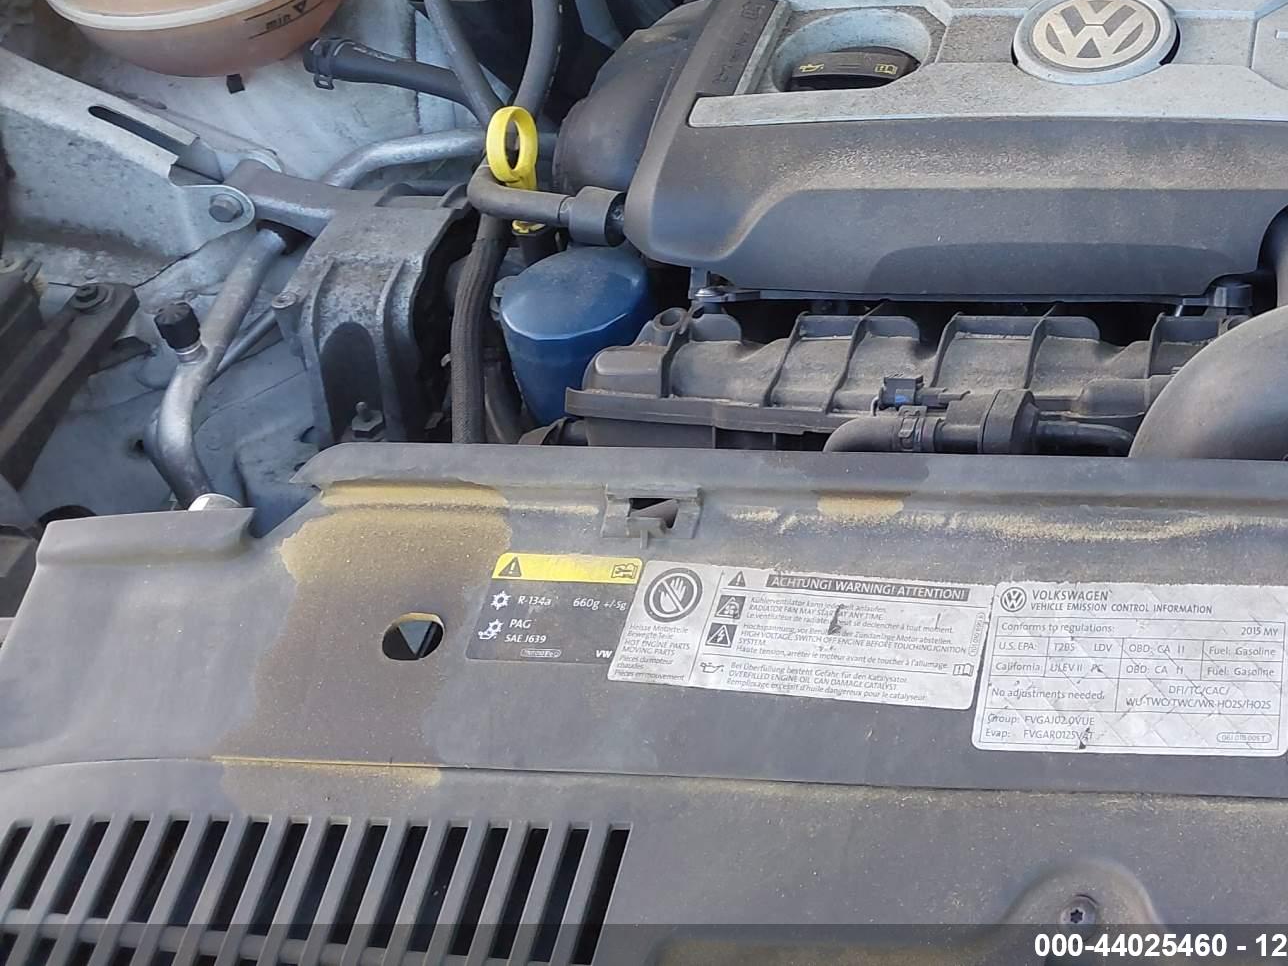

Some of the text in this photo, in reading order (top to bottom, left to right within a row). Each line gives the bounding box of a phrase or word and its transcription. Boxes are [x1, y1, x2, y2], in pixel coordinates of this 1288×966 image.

[265, 14, 292, 31] min
[771, 577, 965, 600] ACHTUNG! WARNING! ATTENTION!
[1032, 589, 1109, 601] VOLKSWAGEN
[517, 595, 552, 607] R-134a
[573, 597, 600, 611] 660g
[1030, 602, 1213, 614] VEHICLE EMISSION CONTROL INFORMATION
[509, 618, 531, 630] PAG
[1001, 621, 1046, 632] Conforms
[1061, 622, 1115, 634] regulations:
[1241, 626, 1261, 635] 2015
[1264, 628, 1279, 637] MY
[504, 634, 547, 644] SAE J639
[795, 634, 821, 643] SWITCH
[865, 640, 892, 649] BEFORE
[670, 642, 690, 650] PARTS
[998, 641, 1016, 651] U.S.
[1093, 643, 1113, 653] LDV
[1157, 644, 1170, 653] CA
[1209, 645, 1231, 655] Fuel:
[1235, 647, 1276, 657] Gasoline
[995, 662, 1040, 672] California
[1154, 665, 1168, 674] CA
[1207, 666, 1230, 676] Fuel:
[1234, 667, 1275, 677] Gasoline
[771, 674, 797, 683] ENGINE
[800, 676, 811, 684] OIL
[814, 677, 829, 685] CAN
[991, 688, 1005, 697] No
[1007, 689, 1065, 700] adjustments
[1168, 685, 1230, 696] DFI/TC/CAC/
[985, 729, 1011, 738] Evap:
